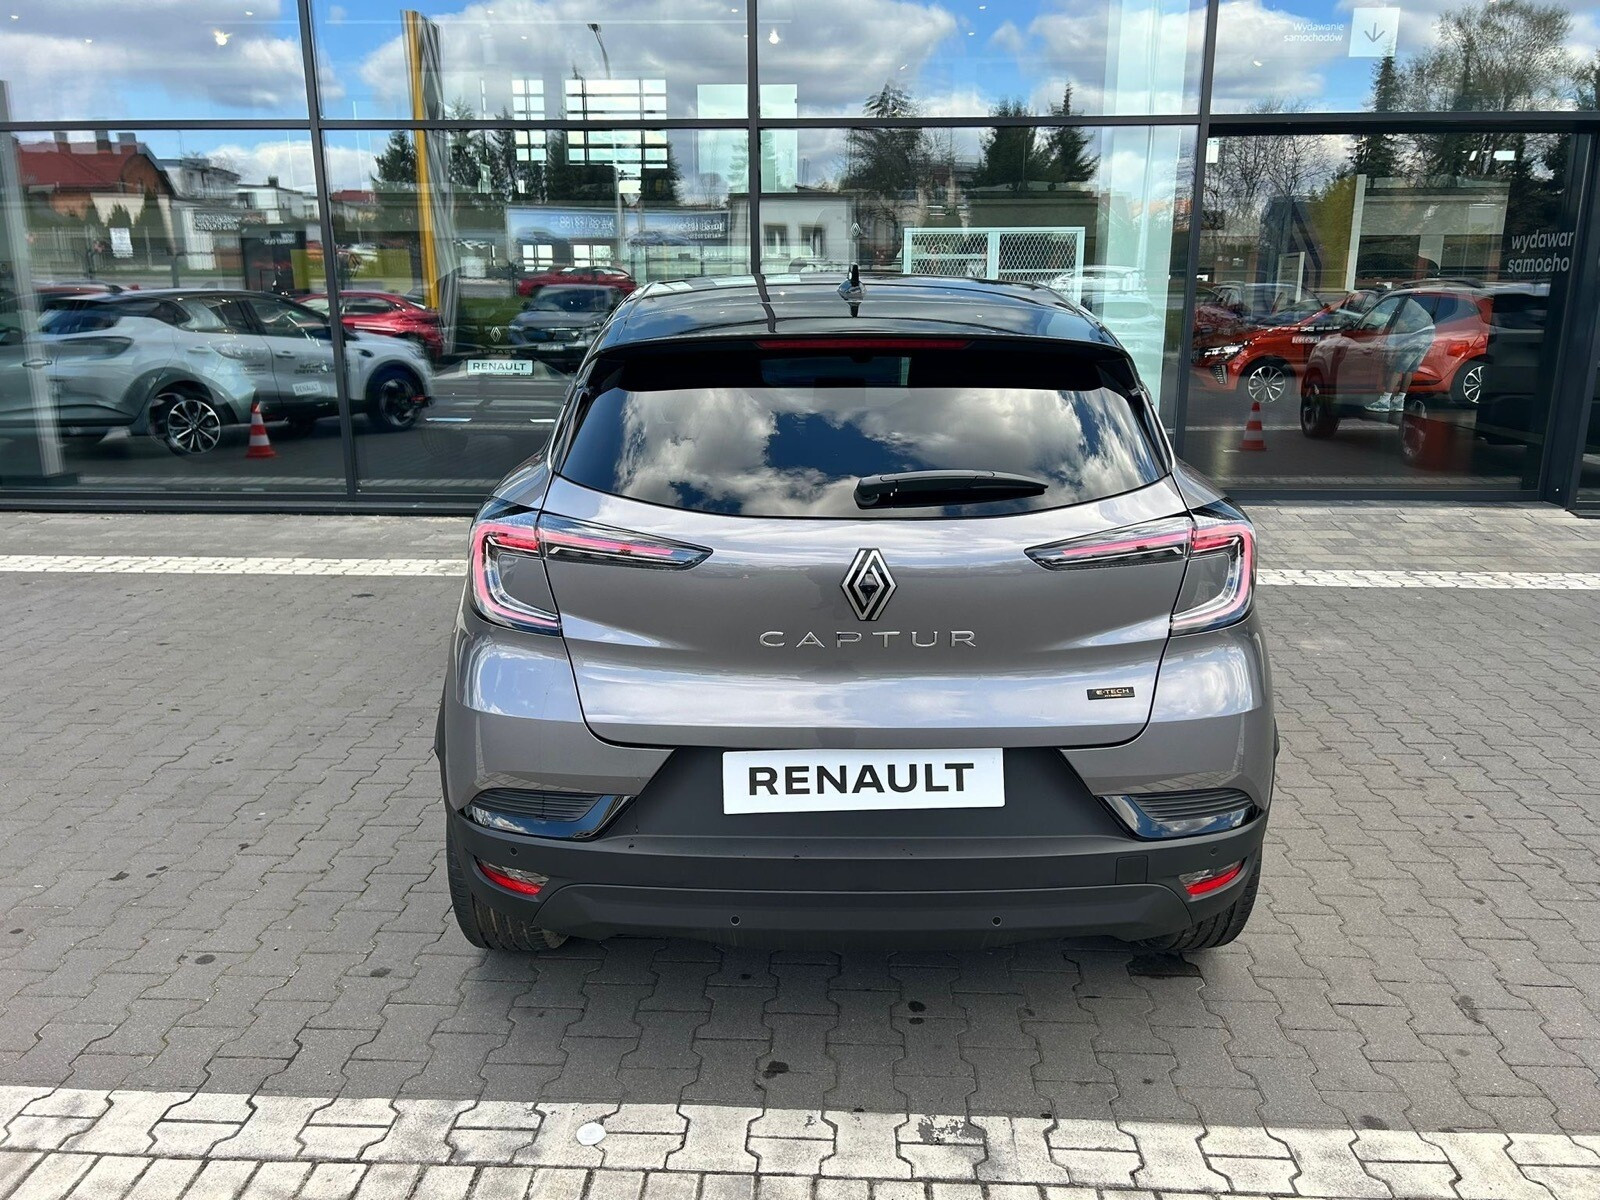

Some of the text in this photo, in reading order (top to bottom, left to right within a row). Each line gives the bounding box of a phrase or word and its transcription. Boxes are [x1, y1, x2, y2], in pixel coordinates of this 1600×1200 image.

[1293, 22, 1344, 32] Wydawanie
[1283, 33, 1343, 42] samochodów
[1507, 252, 1570, 273] samocho
[472, 362, 526, 370] RENAULT
[759, 630, 976, 648] CAPTUR
[749, 763, 974, 796] RENAULT
